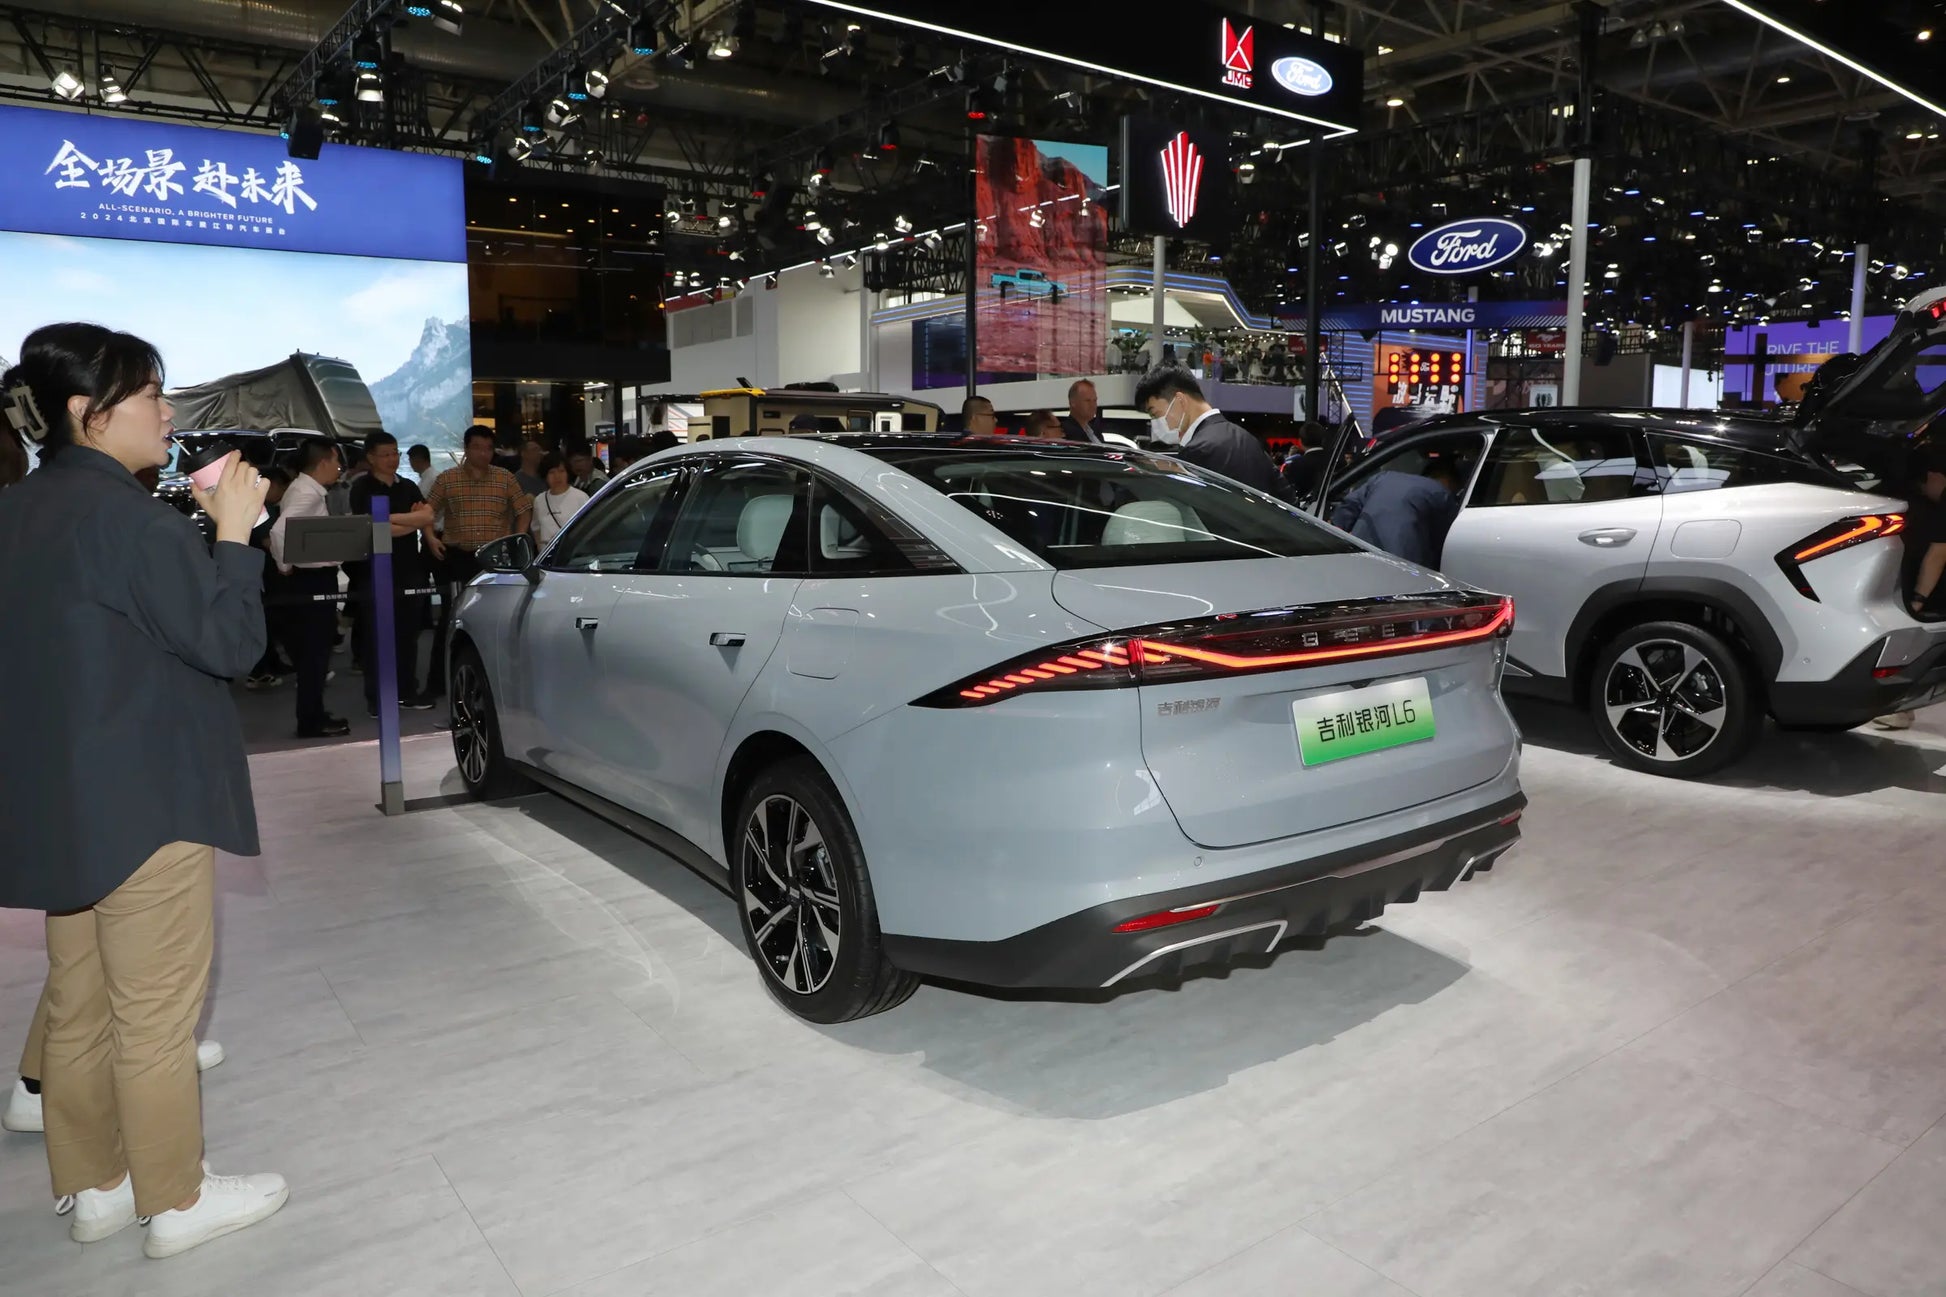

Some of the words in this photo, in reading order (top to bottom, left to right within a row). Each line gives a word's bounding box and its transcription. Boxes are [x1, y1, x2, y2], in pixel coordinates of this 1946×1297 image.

[44, 139, 187, 201] 全场景
[192, 158, 318, 215] 赴未来
[187, 210, 235, 221] BRIGHTER
[237, 214, 273, 224] FUTURE
[1430, 229, 1499, 267] Ford
[1381, 308, 1475, 324] MUSTANG
[1316, 699, 1416, 743] 吉利银河L6
